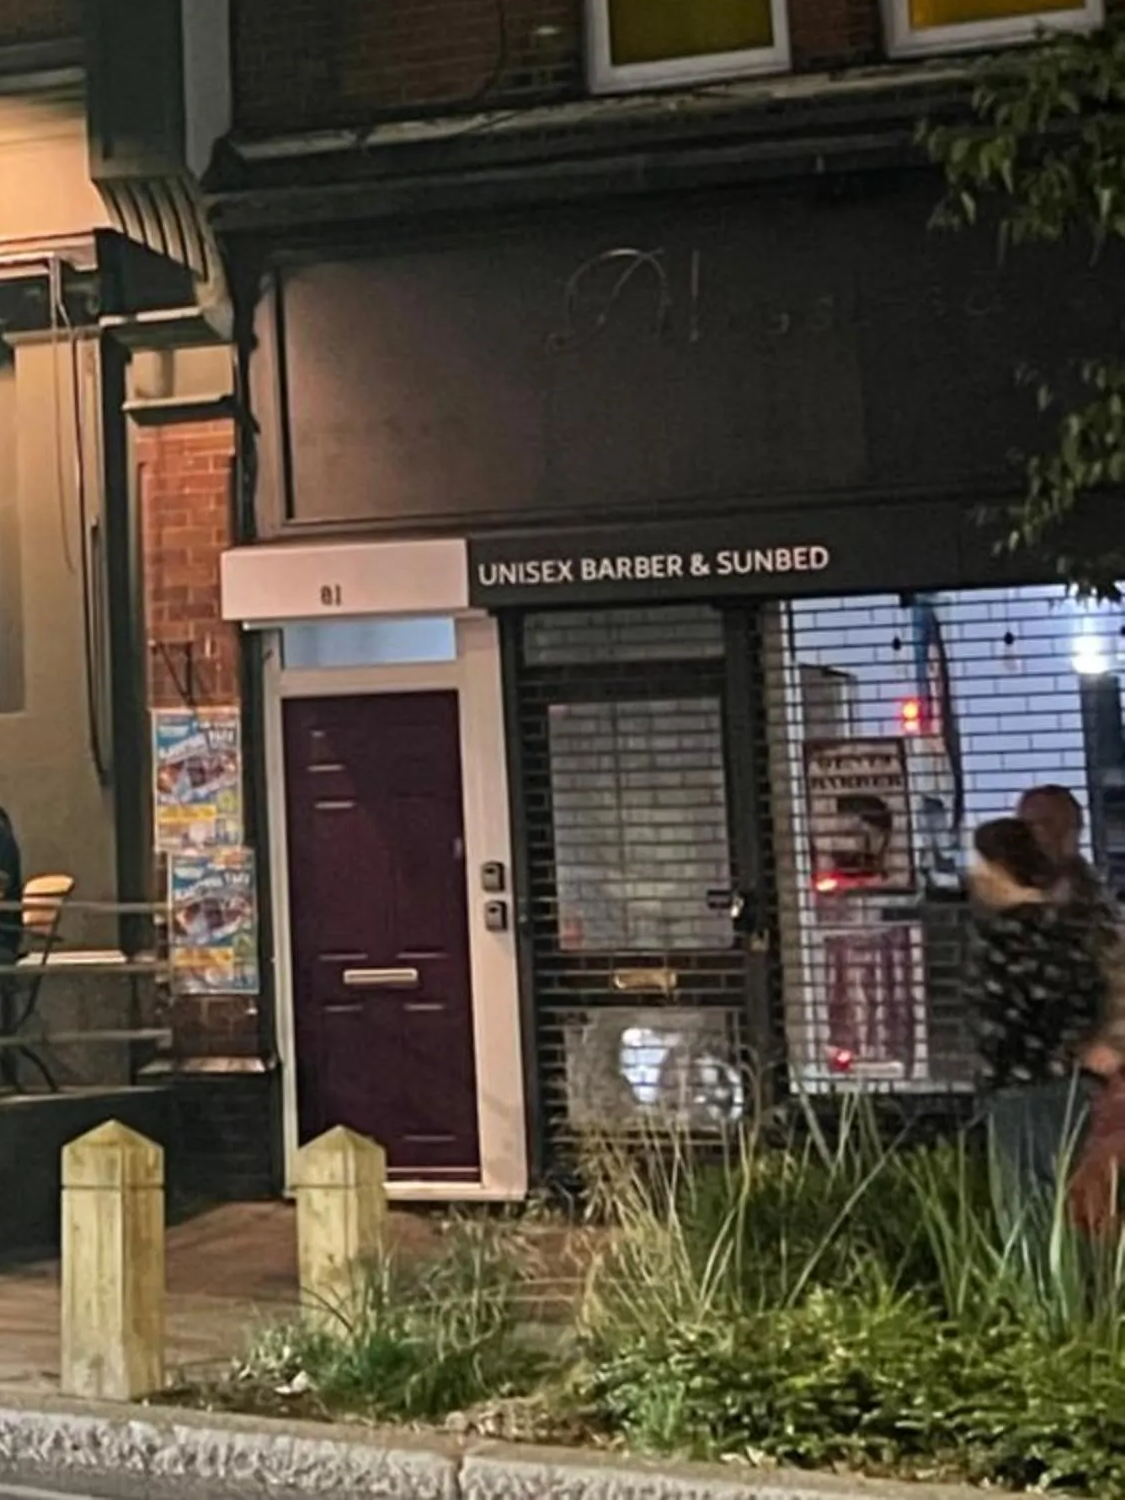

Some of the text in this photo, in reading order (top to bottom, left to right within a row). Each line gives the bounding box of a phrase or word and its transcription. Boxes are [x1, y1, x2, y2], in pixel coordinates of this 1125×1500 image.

[478, 545, 829, 586] UNISEX BARBER & SUNBED
[321, 584, 341, 606] 81
